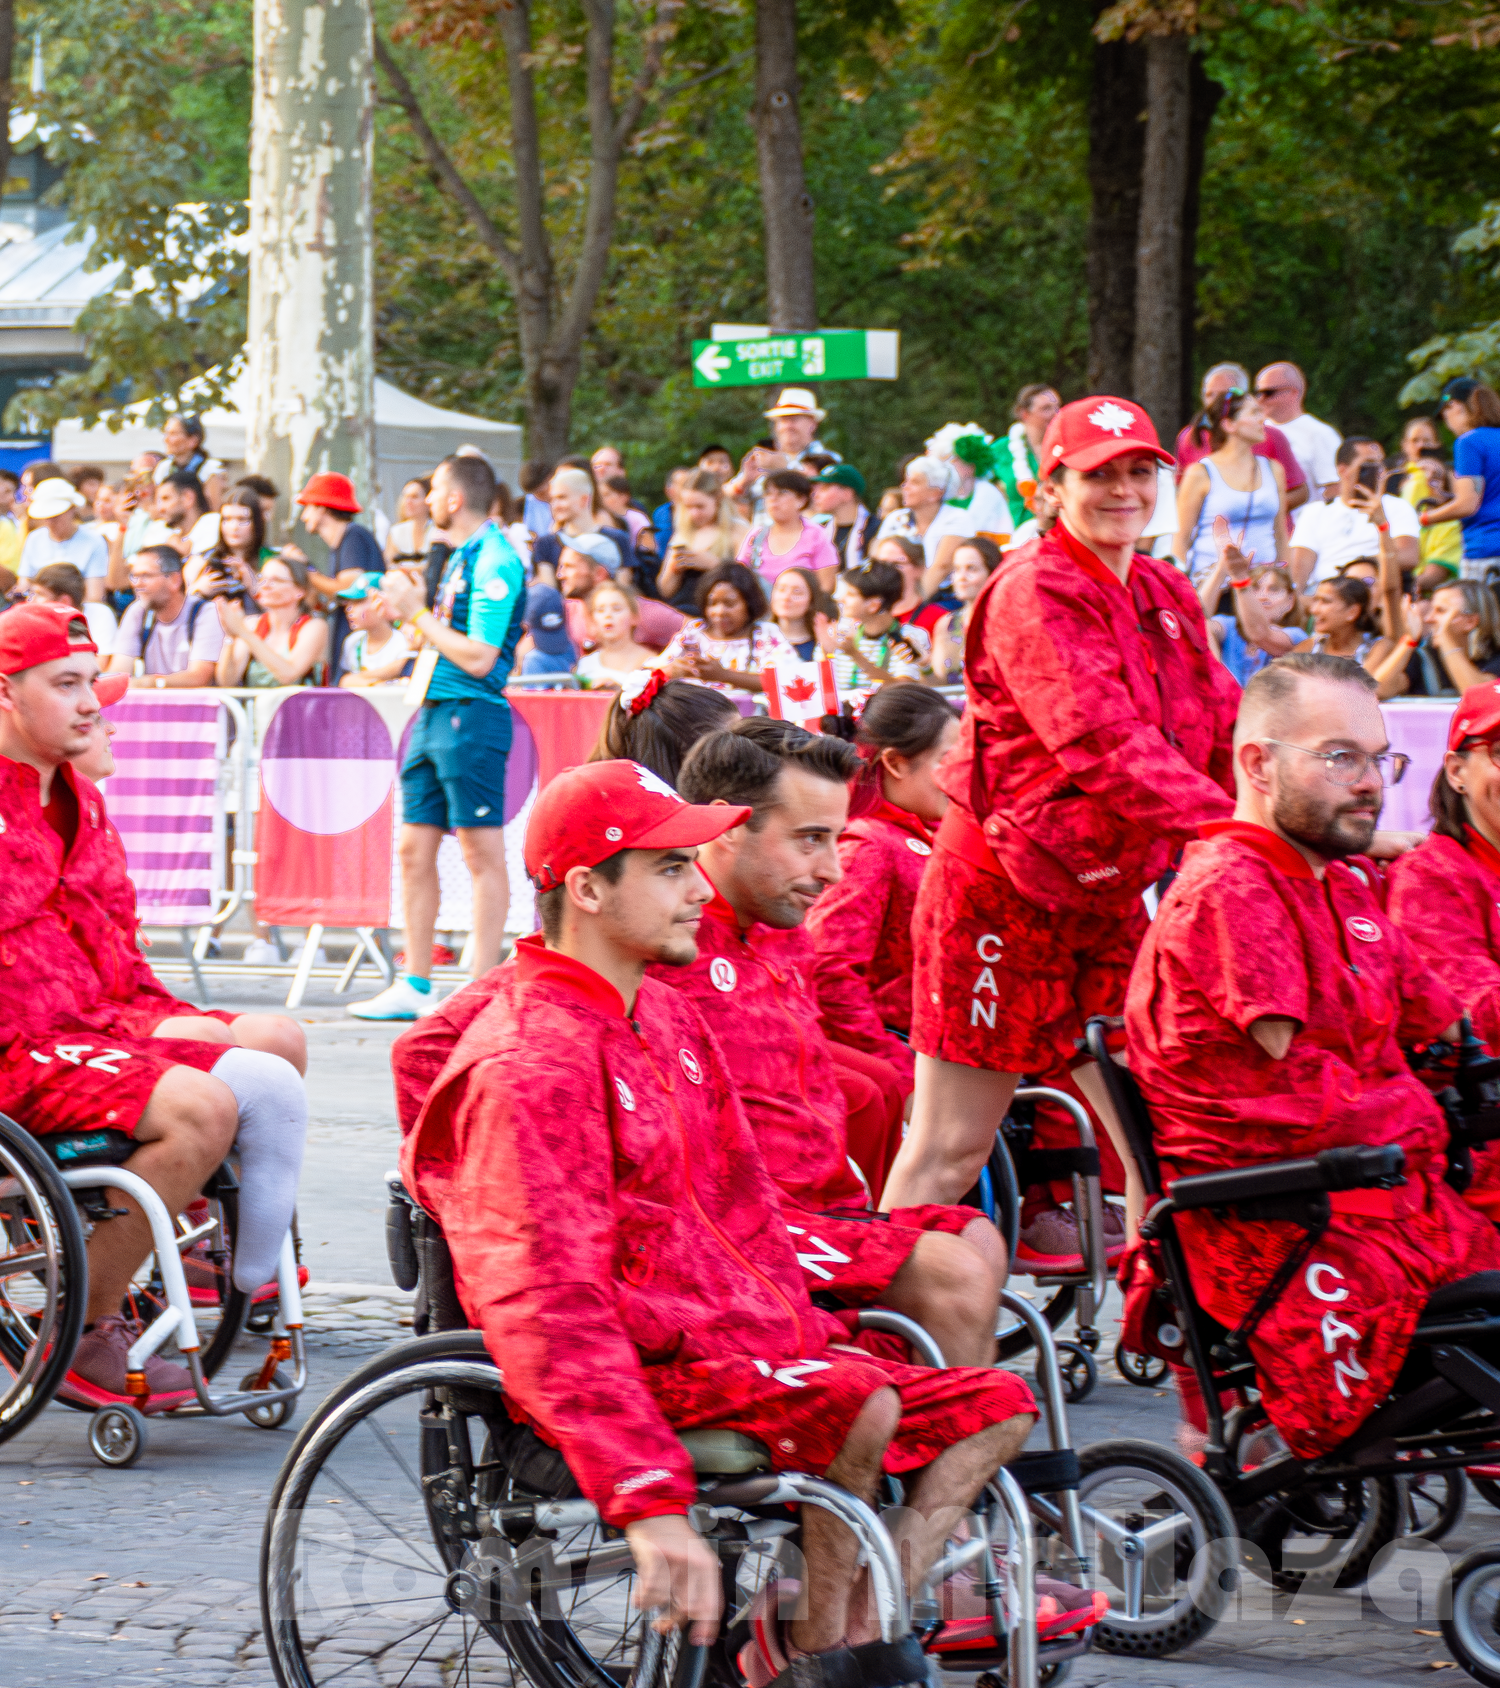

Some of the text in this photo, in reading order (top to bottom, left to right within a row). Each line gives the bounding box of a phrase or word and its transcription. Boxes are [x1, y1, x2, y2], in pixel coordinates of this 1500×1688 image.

[736, 338, 797, 362] SORTIE
[748, 360, 784, 379] EXIT
[1076, 865, 1121, 883] CANADA
[970, 933, 1004, 1030] CAN
[1305, 1262, 1370, 1398] CAN
